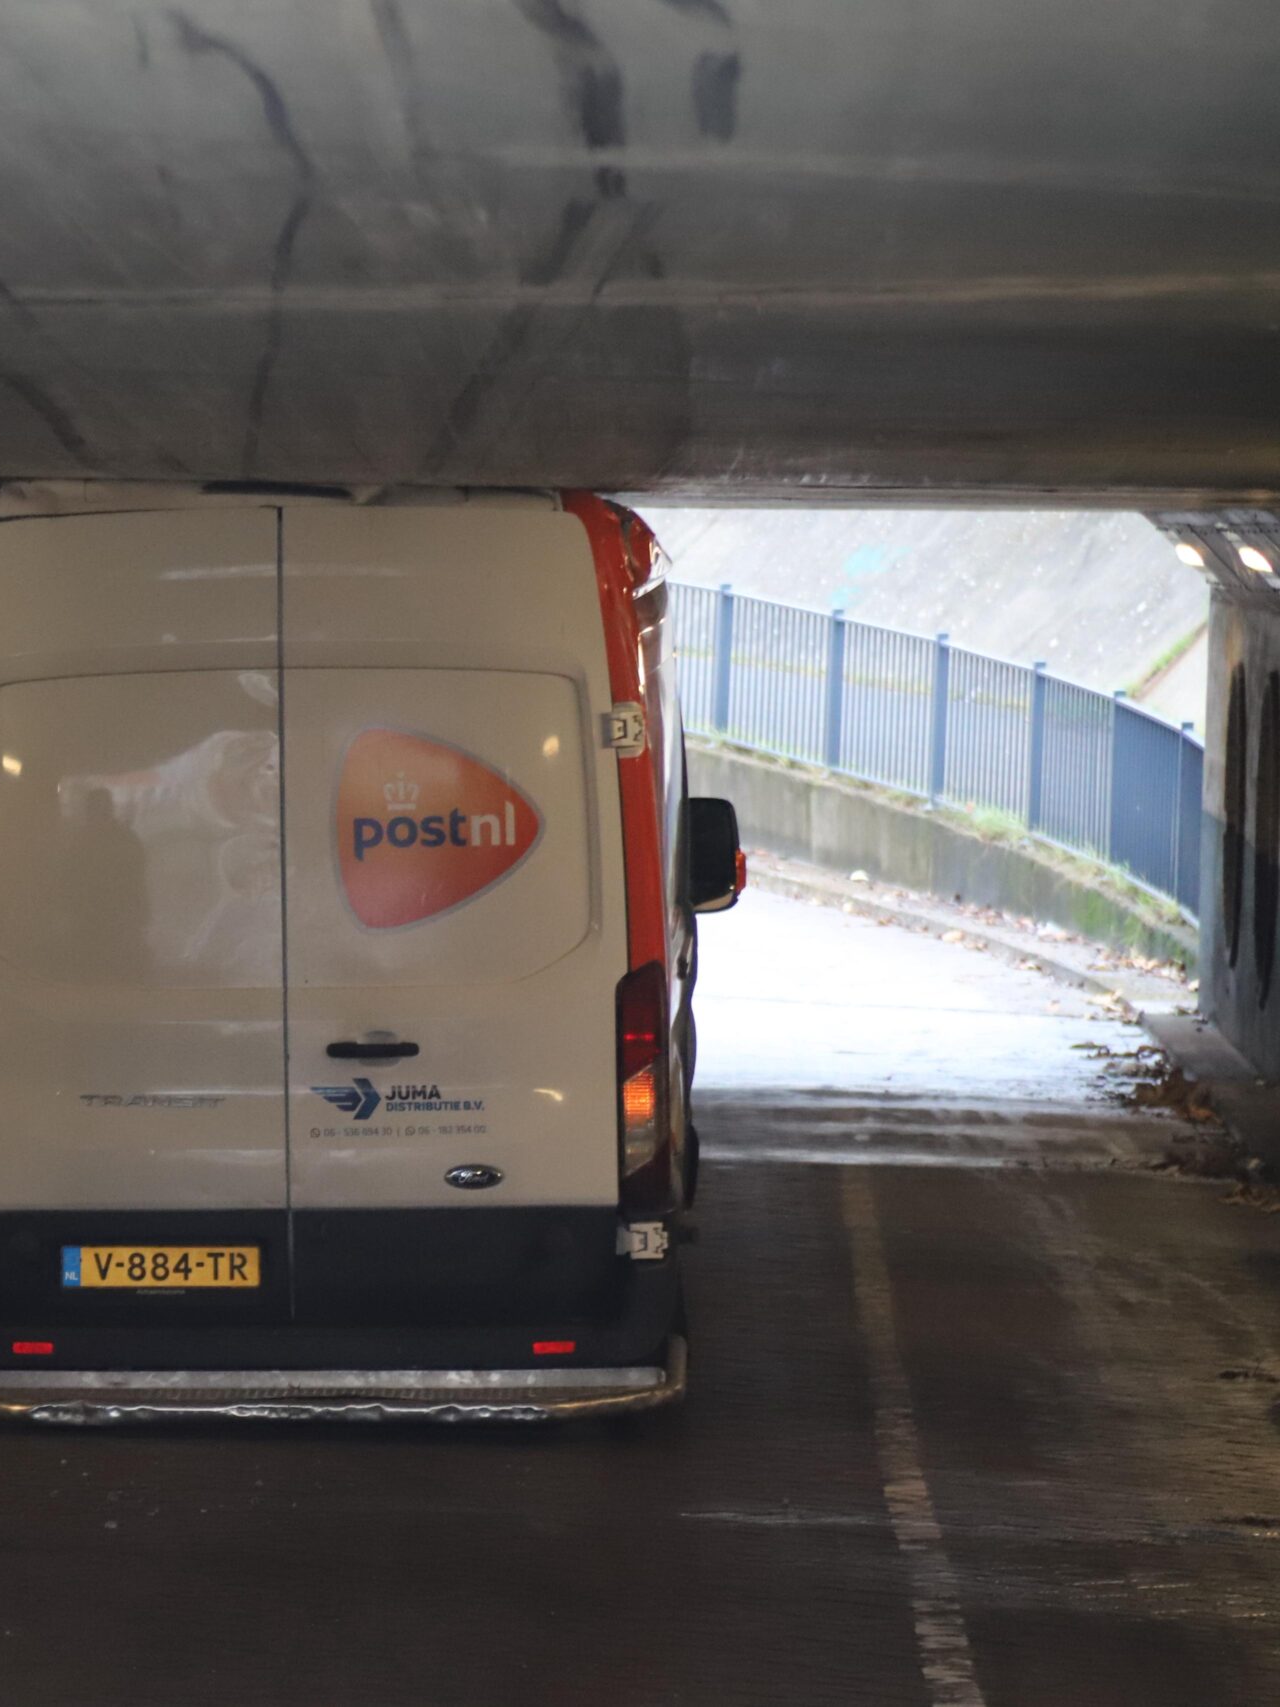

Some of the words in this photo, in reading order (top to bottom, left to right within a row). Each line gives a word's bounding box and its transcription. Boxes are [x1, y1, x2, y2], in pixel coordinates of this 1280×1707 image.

[353, 800, 516, 861] postnl
[80, 1094, 226, 1108] TRANSIT
[385, 1085, 441, 1101] JUMA
[386, 1101, 461, 1112] DISTRIBUTIE
[463, 1100, 485, 1111] B.V.
[64, 1271, 78, 1281] NL
[94, 1252, 248, 1281] V-884-TR
